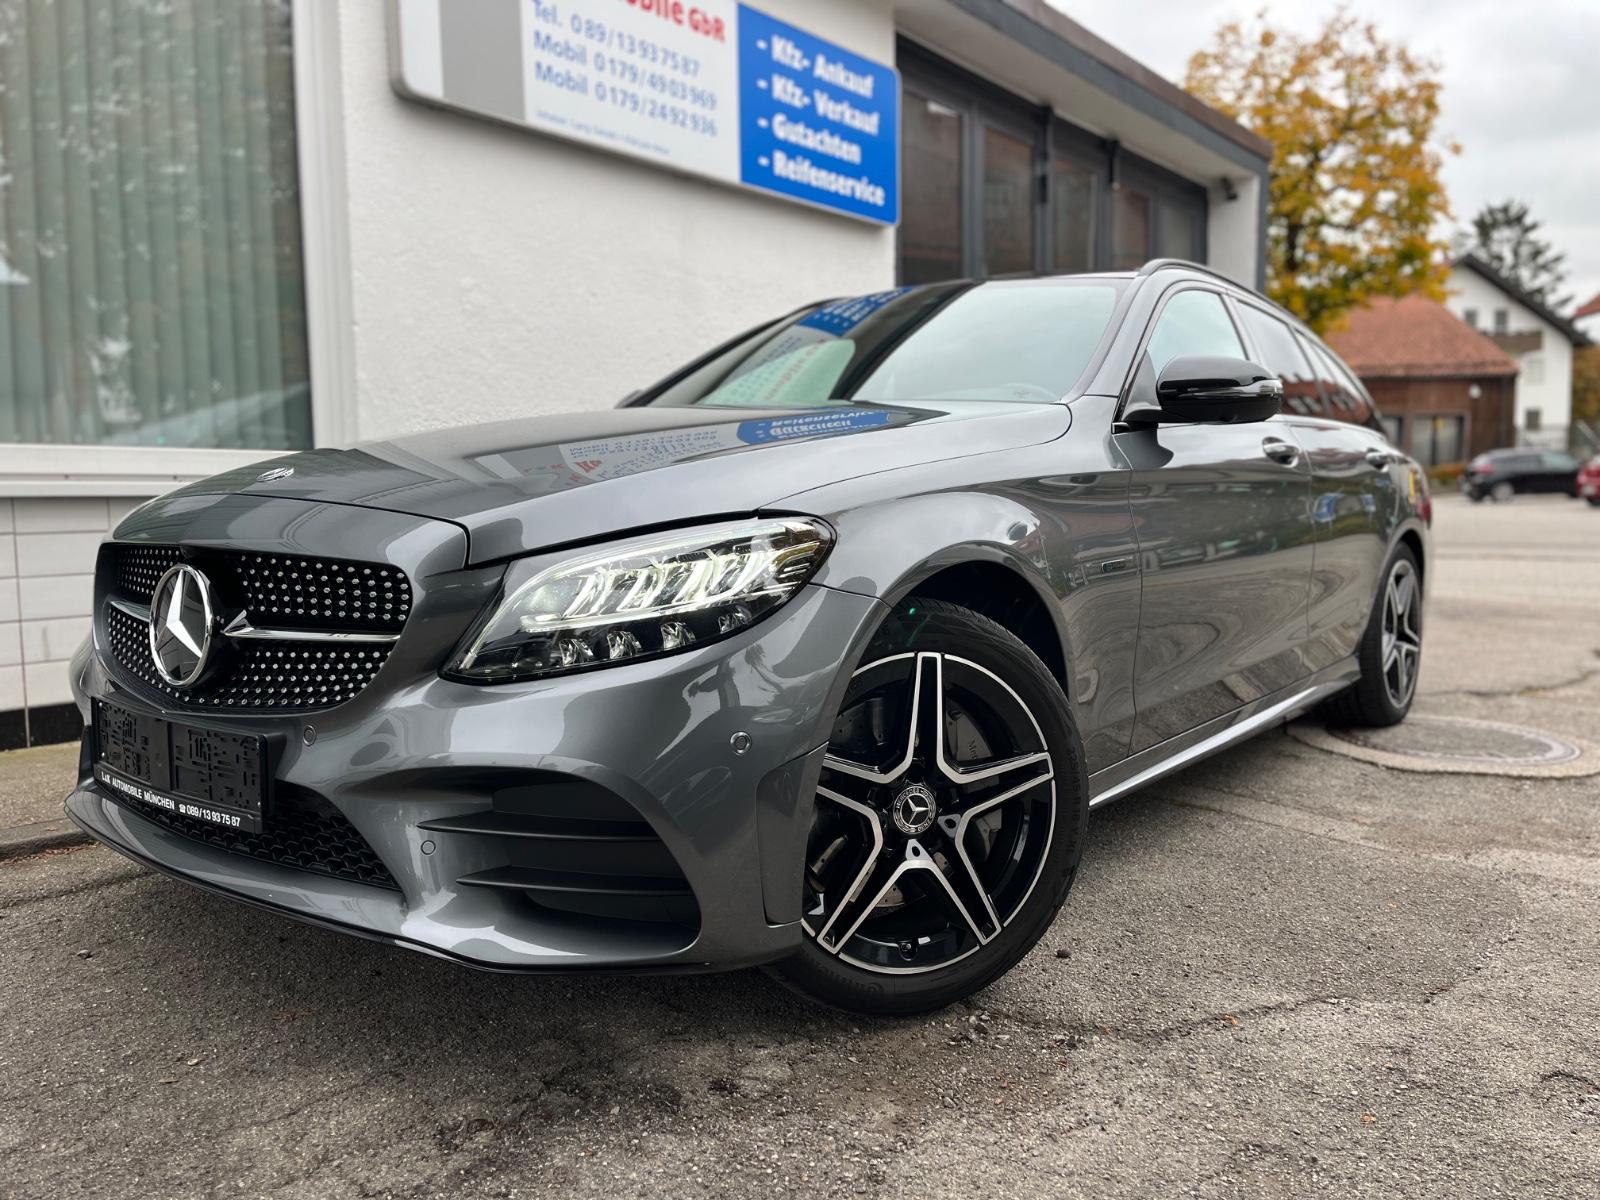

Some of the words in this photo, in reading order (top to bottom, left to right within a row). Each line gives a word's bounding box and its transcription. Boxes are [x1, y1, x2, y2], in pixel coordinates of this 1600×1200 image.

[534, 0, 563, 28] Tel.
[688, 7, 725, 43] GbR
[534, 30, 587, 66] Mobil
[535, 61, 588, 96] Mobil
[813, 53, 874, 98] Ankauf
[813, 89, 880, 136] Verkauf
[771, 112, 862, 165] Gutachten
[773, 149, 886, 207] Reifenservice
[112, 777, 143, 800] AUTOMOBILE
[143, 790, 175, 811] MÜNCHEN
